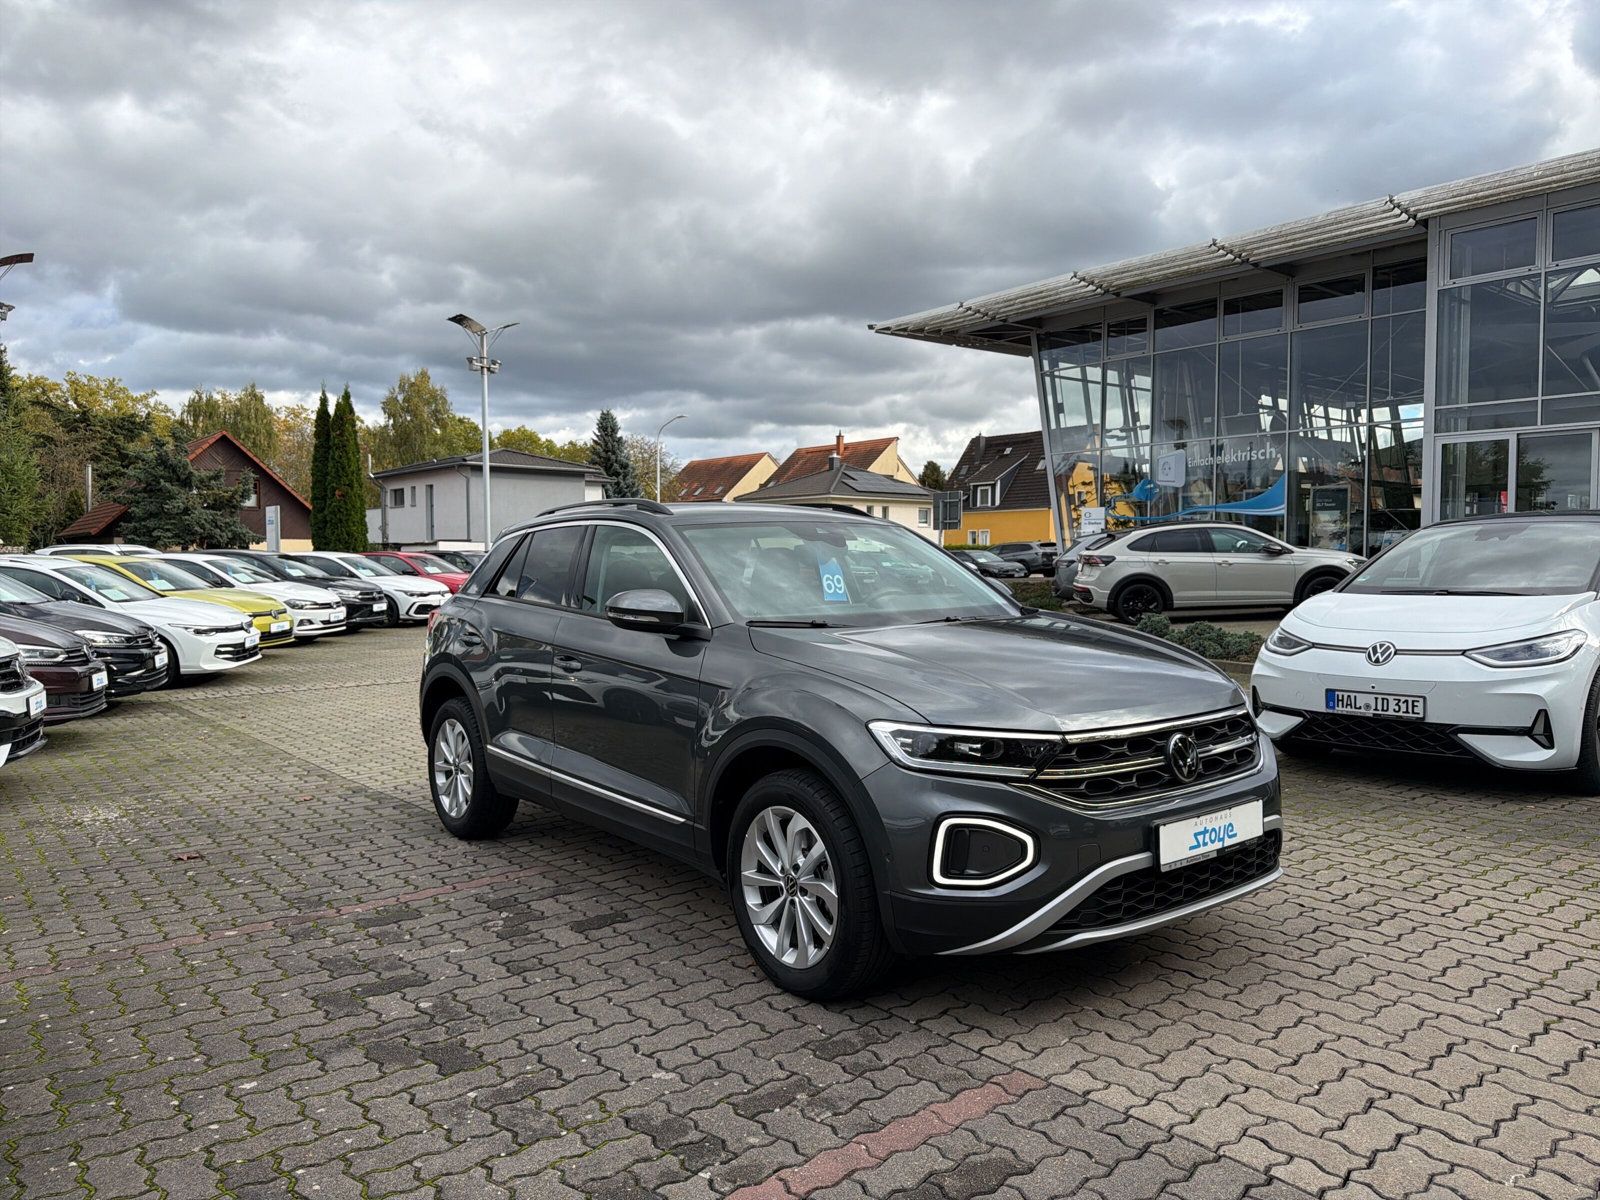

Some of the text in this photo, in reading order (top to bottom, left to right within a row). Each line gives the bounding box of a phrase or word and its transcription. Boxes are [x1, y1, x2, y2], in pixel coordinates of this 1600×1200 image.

[1188, 456, 1214, 468] Einfach
[822, 574, 845, 594] 69
[1336, 693, 1362, 710] HAL
[1373, 697, 1390, 712] ID
[1393, 698, 1420, 715] 31E
[1194, 811, 1233, 826] AUTOHAUS
